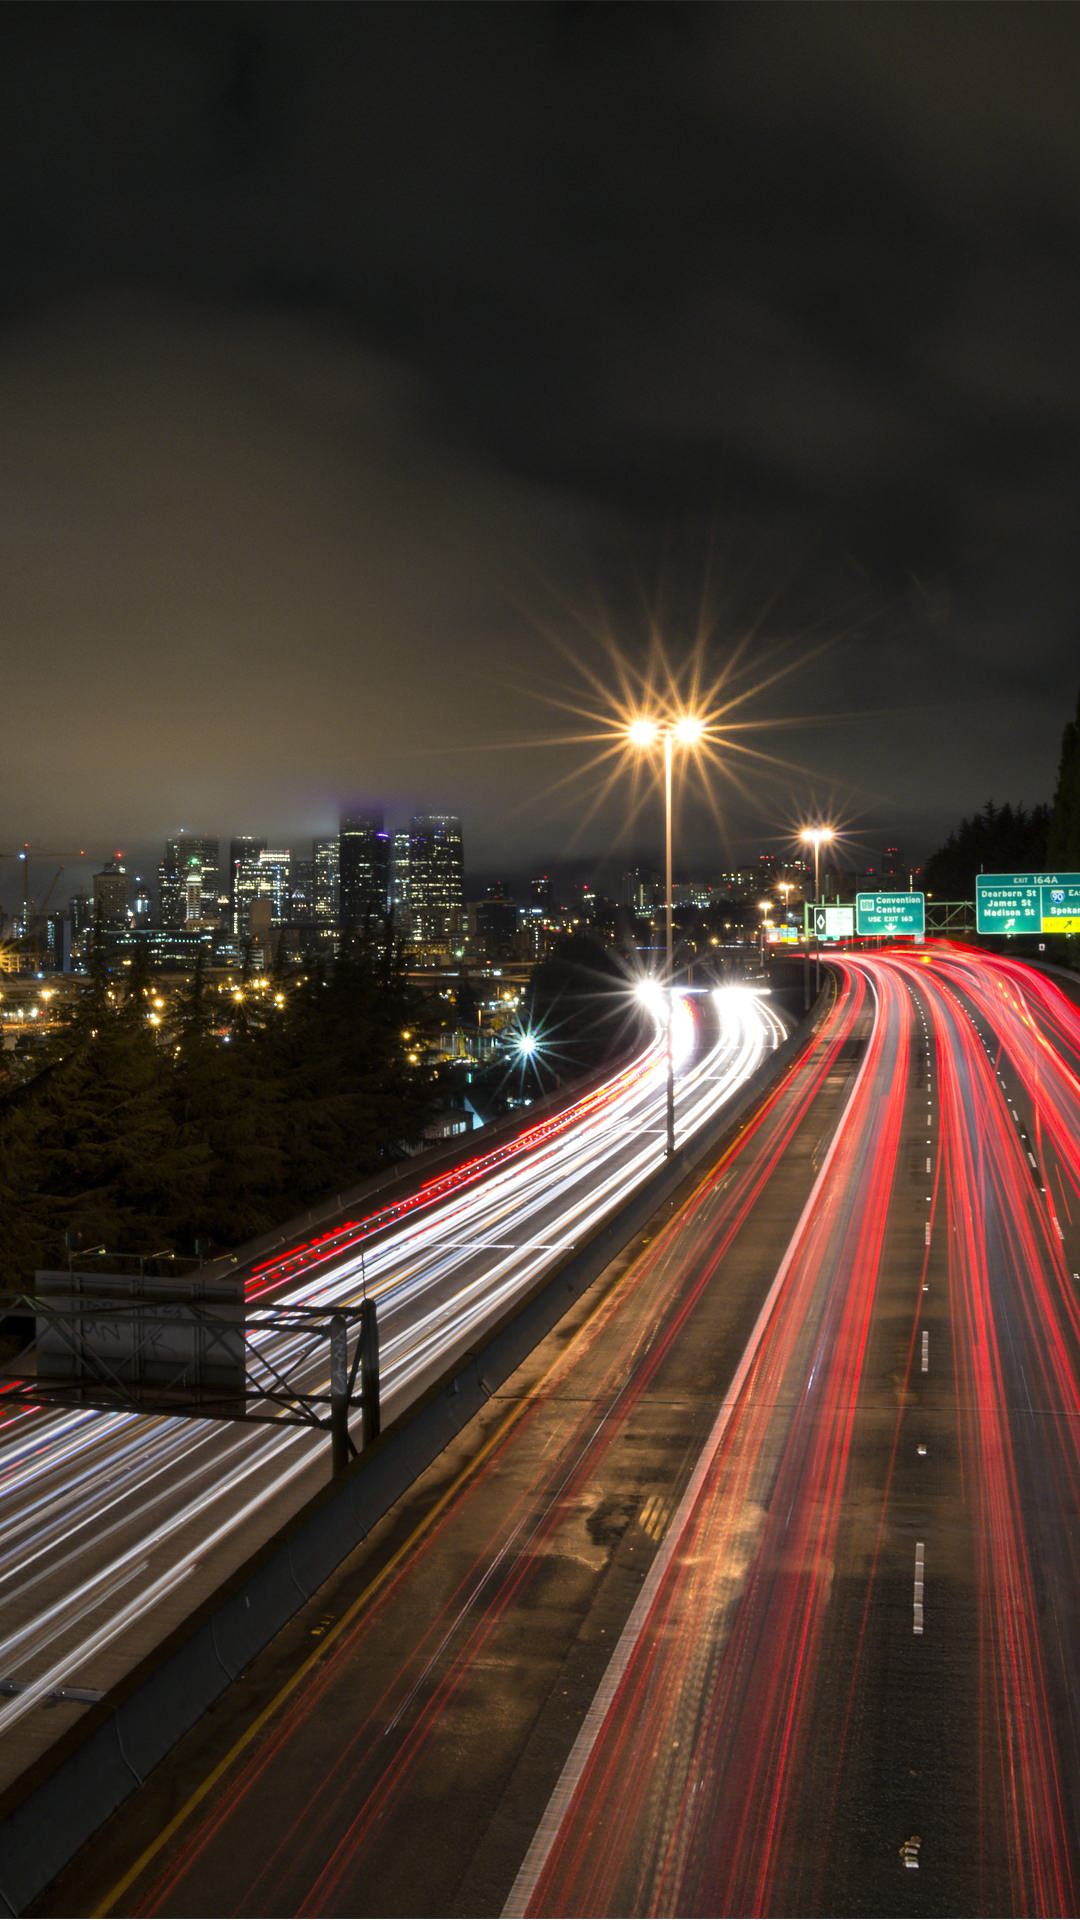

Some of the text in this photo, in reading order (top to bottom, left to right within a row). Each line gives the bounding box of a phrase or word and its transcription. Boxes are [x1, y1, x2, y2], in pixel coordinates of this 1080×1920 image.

[1033, 876, 1058, 884] 164A
[981, 889, 1037, 898] Dearborn St
[1068, 889, 1080, 897] EA
[876, 896, 921, 904] Convention
[987, 899, 1032, 907] James St
[876, 906, 906, 914] Center
[983, 908, 1035, 917] Madison St
